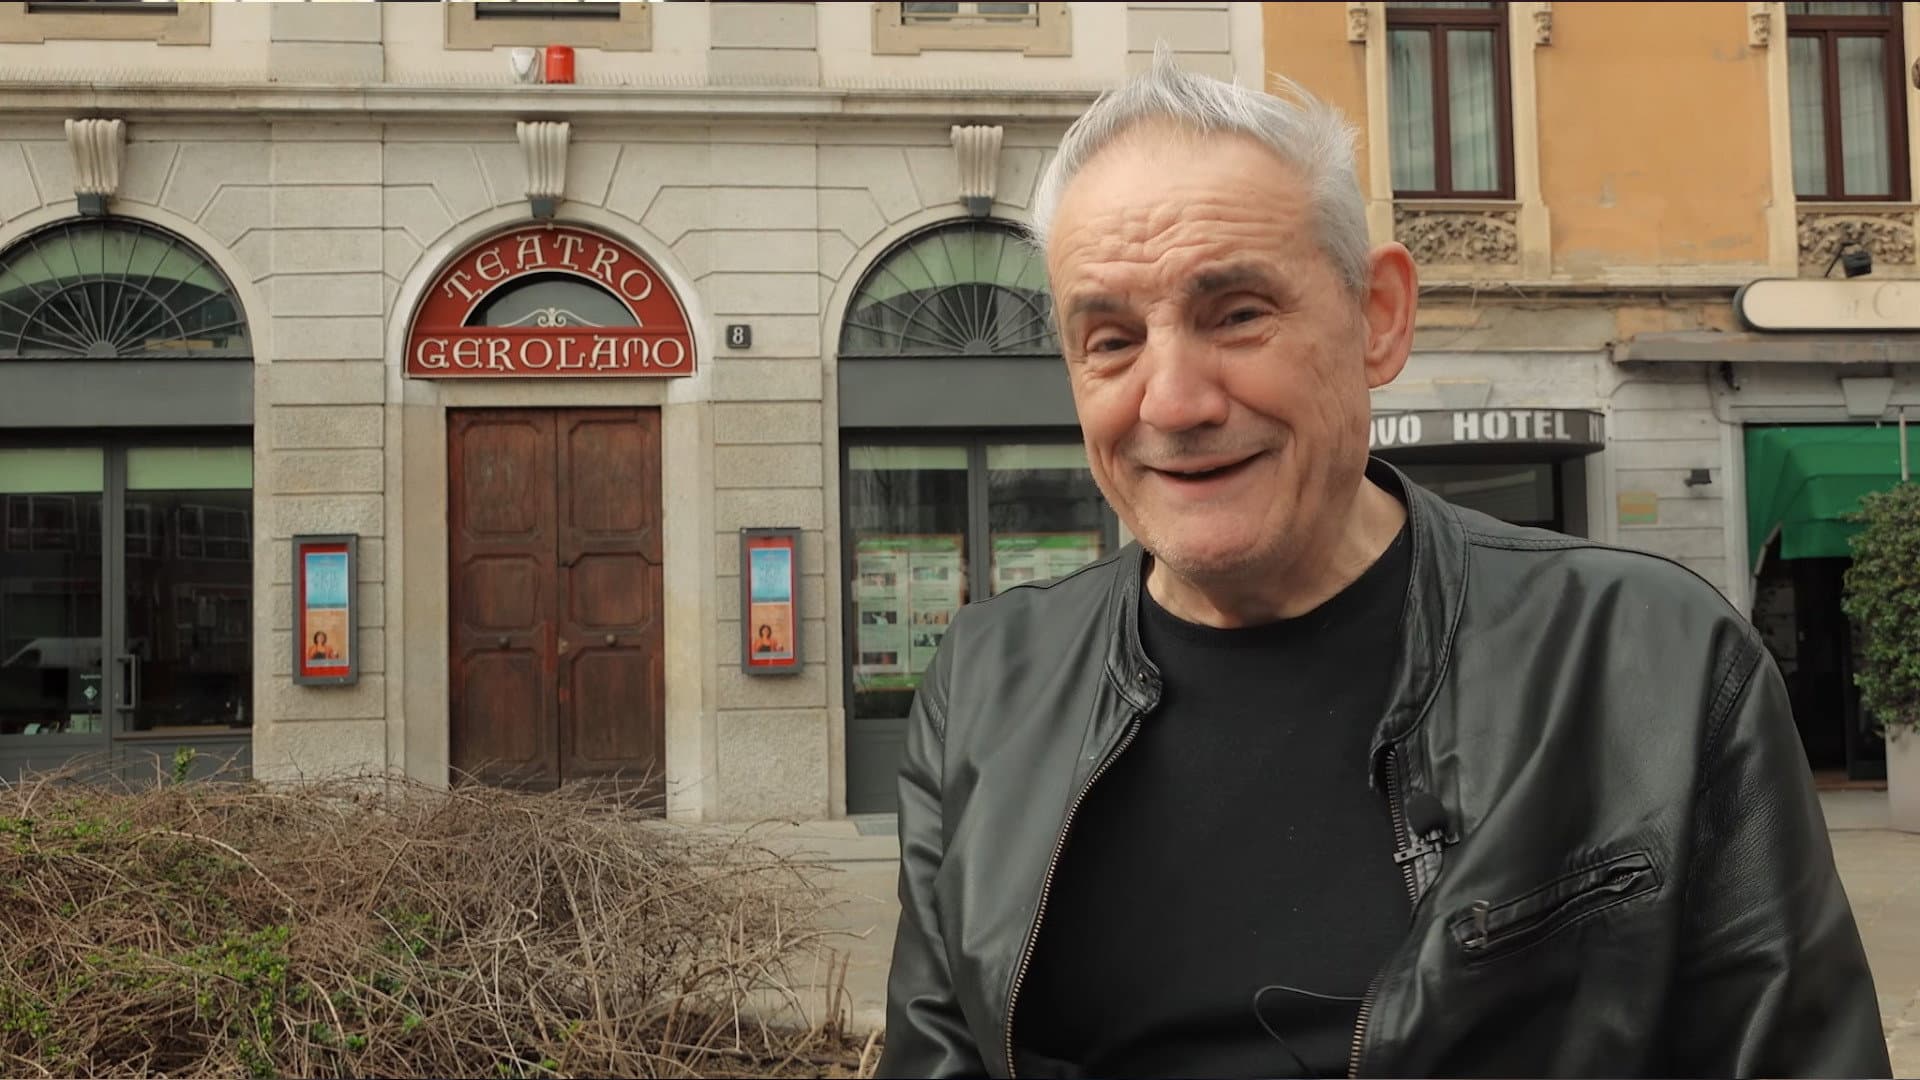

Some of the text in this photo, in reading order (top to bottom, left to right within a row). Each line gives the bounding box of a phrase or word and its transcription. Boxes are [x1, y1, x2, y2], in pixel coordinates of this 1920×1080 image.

[443, 234, 653, 303] TEATRO
[416, 334, 686, 371] GEROLAMO
[732, 327, 744, 345] 8
[1453, 411, 1571, 441] HOTEL
